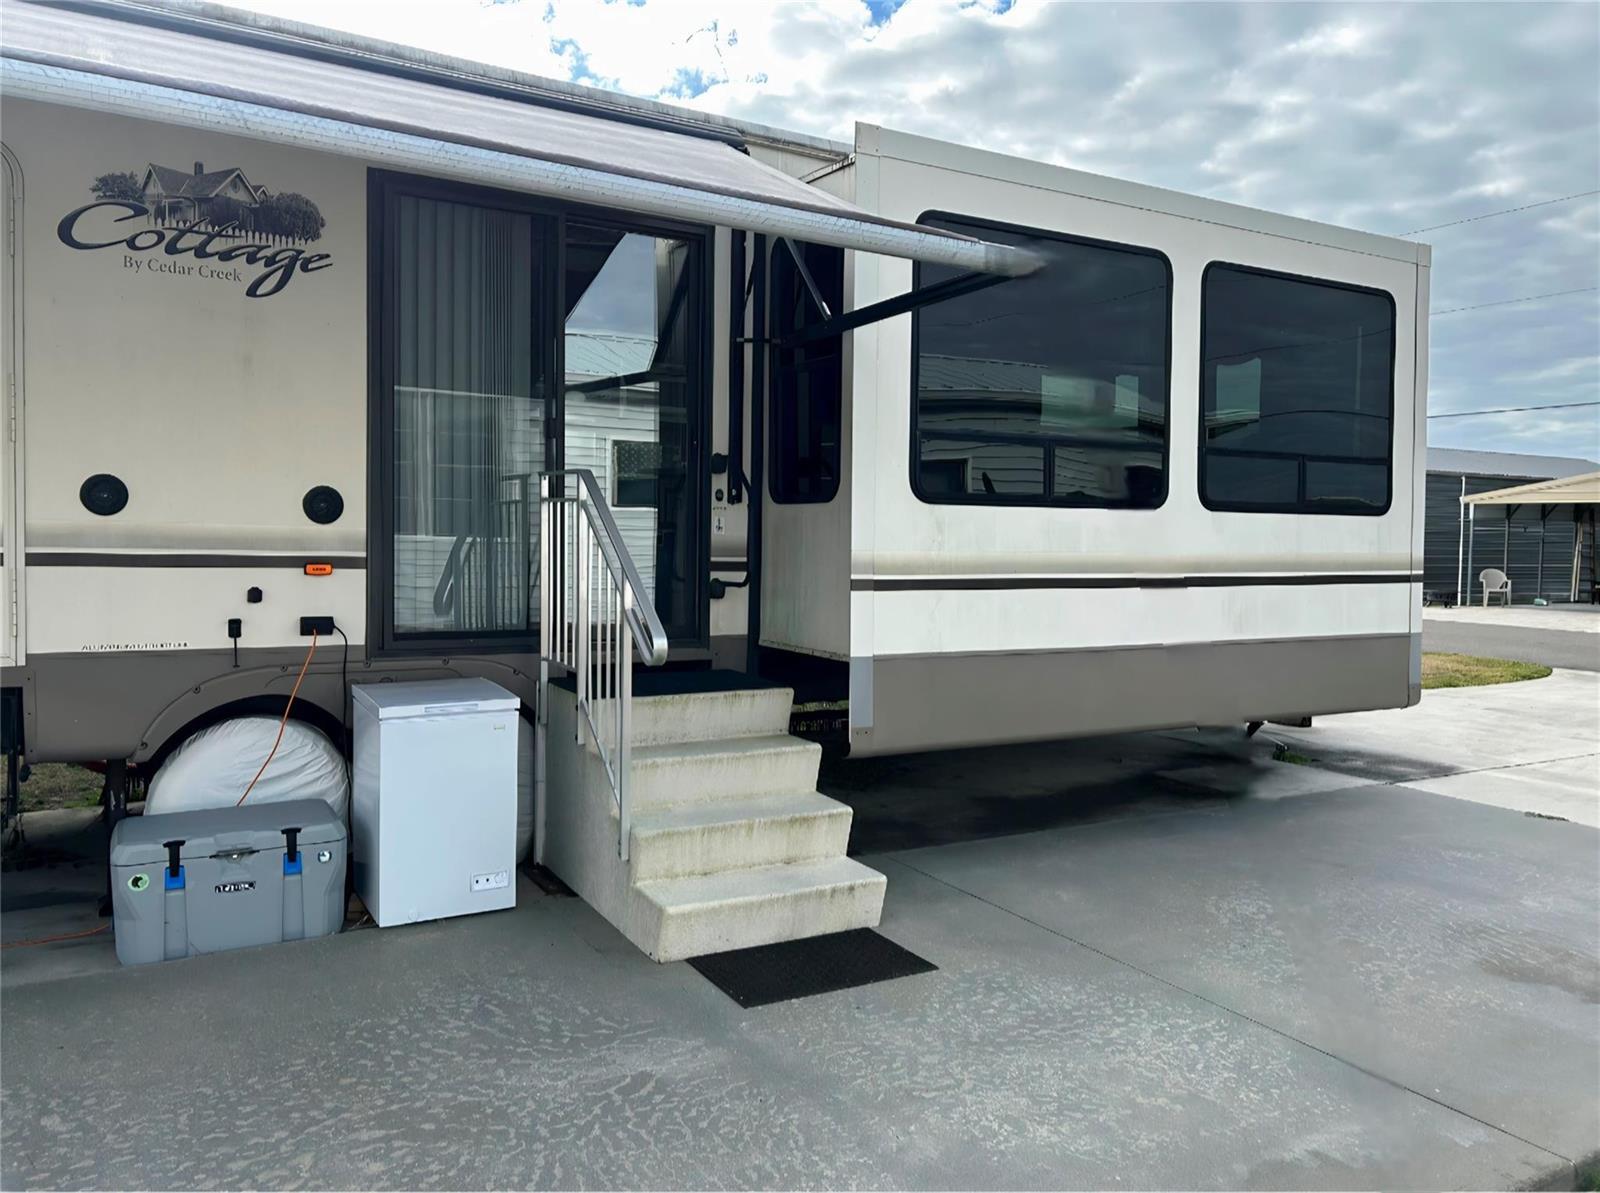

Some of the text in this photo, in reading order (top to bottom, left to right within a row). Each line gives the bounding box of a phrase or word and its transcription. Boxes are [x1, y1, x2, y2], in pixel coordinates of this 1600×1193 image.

[57, 201, 334, 298] Cottage
[123, 255, 242, 282] By Cedar Creek
